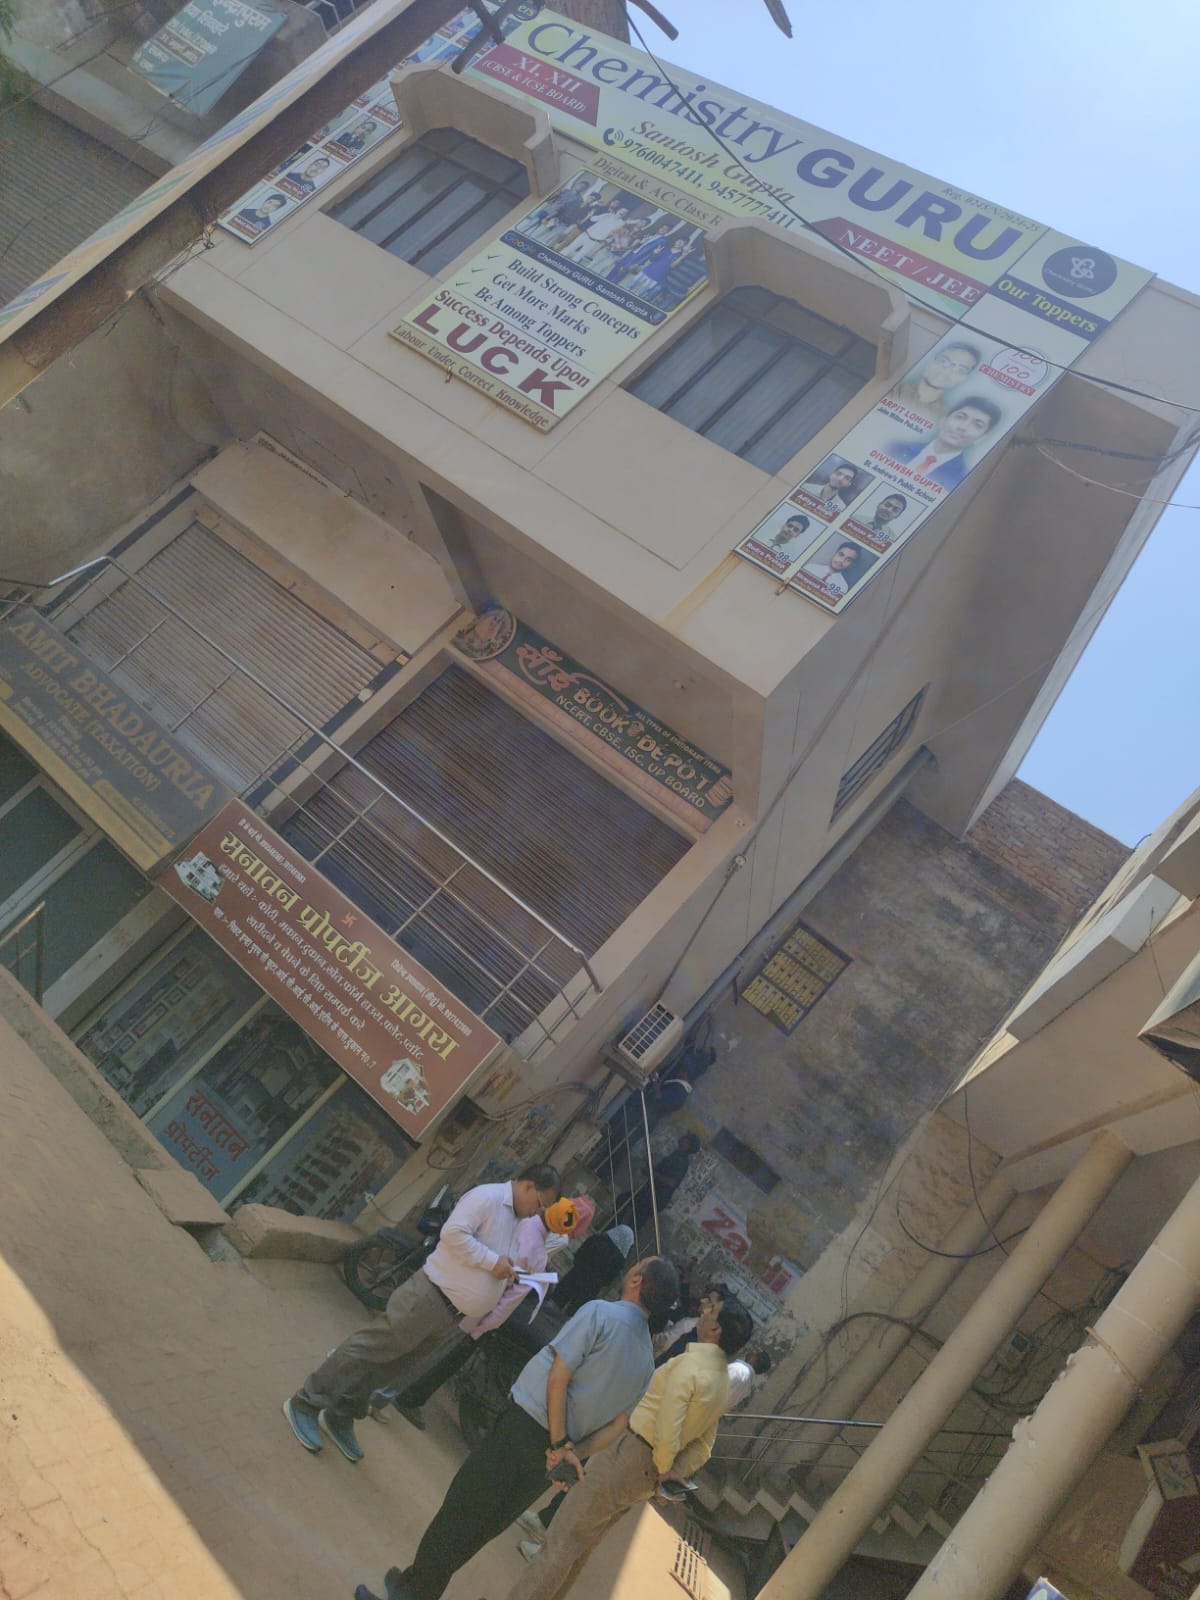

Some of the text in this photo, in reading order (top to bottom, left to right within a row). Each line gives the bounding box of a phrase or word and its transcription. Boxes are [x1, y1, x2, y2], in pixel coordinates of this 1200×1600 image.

[511, 72, 522, 81] &
[519, 77, 547, 92] ICSE
[545, 88, 586, 113] BOARD)
[542, 71, 582, 93] XII
[528, 21, 1023, 262] Chemistry GURU
[630, 119, 794, 202] Santosh Gupta
[593, 157, 636, 183] Digital
[634, 177, 648, 190] &
[648, 185, 675, 203] AC
[673, 197, 716, 222] Class
[708, 179, 796, 229] 9457777411
[839, 229, 980, 303] NEET / JEE
[474, 286, 586, 357] Be Among Toppers
[491, 272, 590, 334] Get More Marks
[507, 258, 641, 339] Build Strong Concepts
[997, 278, 1098, 332] Our Toppers
[411, 302, 574, 410] LUCK
[434, 289, 590, 388] Success Depends Upon
[392, 325, 550, 426] Labour Under Correct Knowledge
[880, 398, 933, 429] ARPIT LOHIYA
[869, 449, 943, 494] DIVYANSH GUPTA
[896, 477, 916, 491] Public
[914, 489, 936, 503] School
[7, 619, 79, 675] AMIT
[68, 667, 216, 811] BHADAURIA
[19, 662, 90, 724] ADVOCATE
[83, 718, 162, 793] (TAXATION)
[571, 687, 629, 734] BOOK
[646, 761, 666, 779] UP
[663, 774, 706, 809] BOARD
[217, 862, 239, 883] हमारे
[216, 830, 303, 912] सनातन
[295, 904, 384, 990] प्रोपर्टीज
[377, 983, 461, 1061] आगरा
[297, 964, 311, 978] के
[161, 1119, 220, 1181] प्रोपर्टीज
[183, 1088, 250, 1162] सनातन
